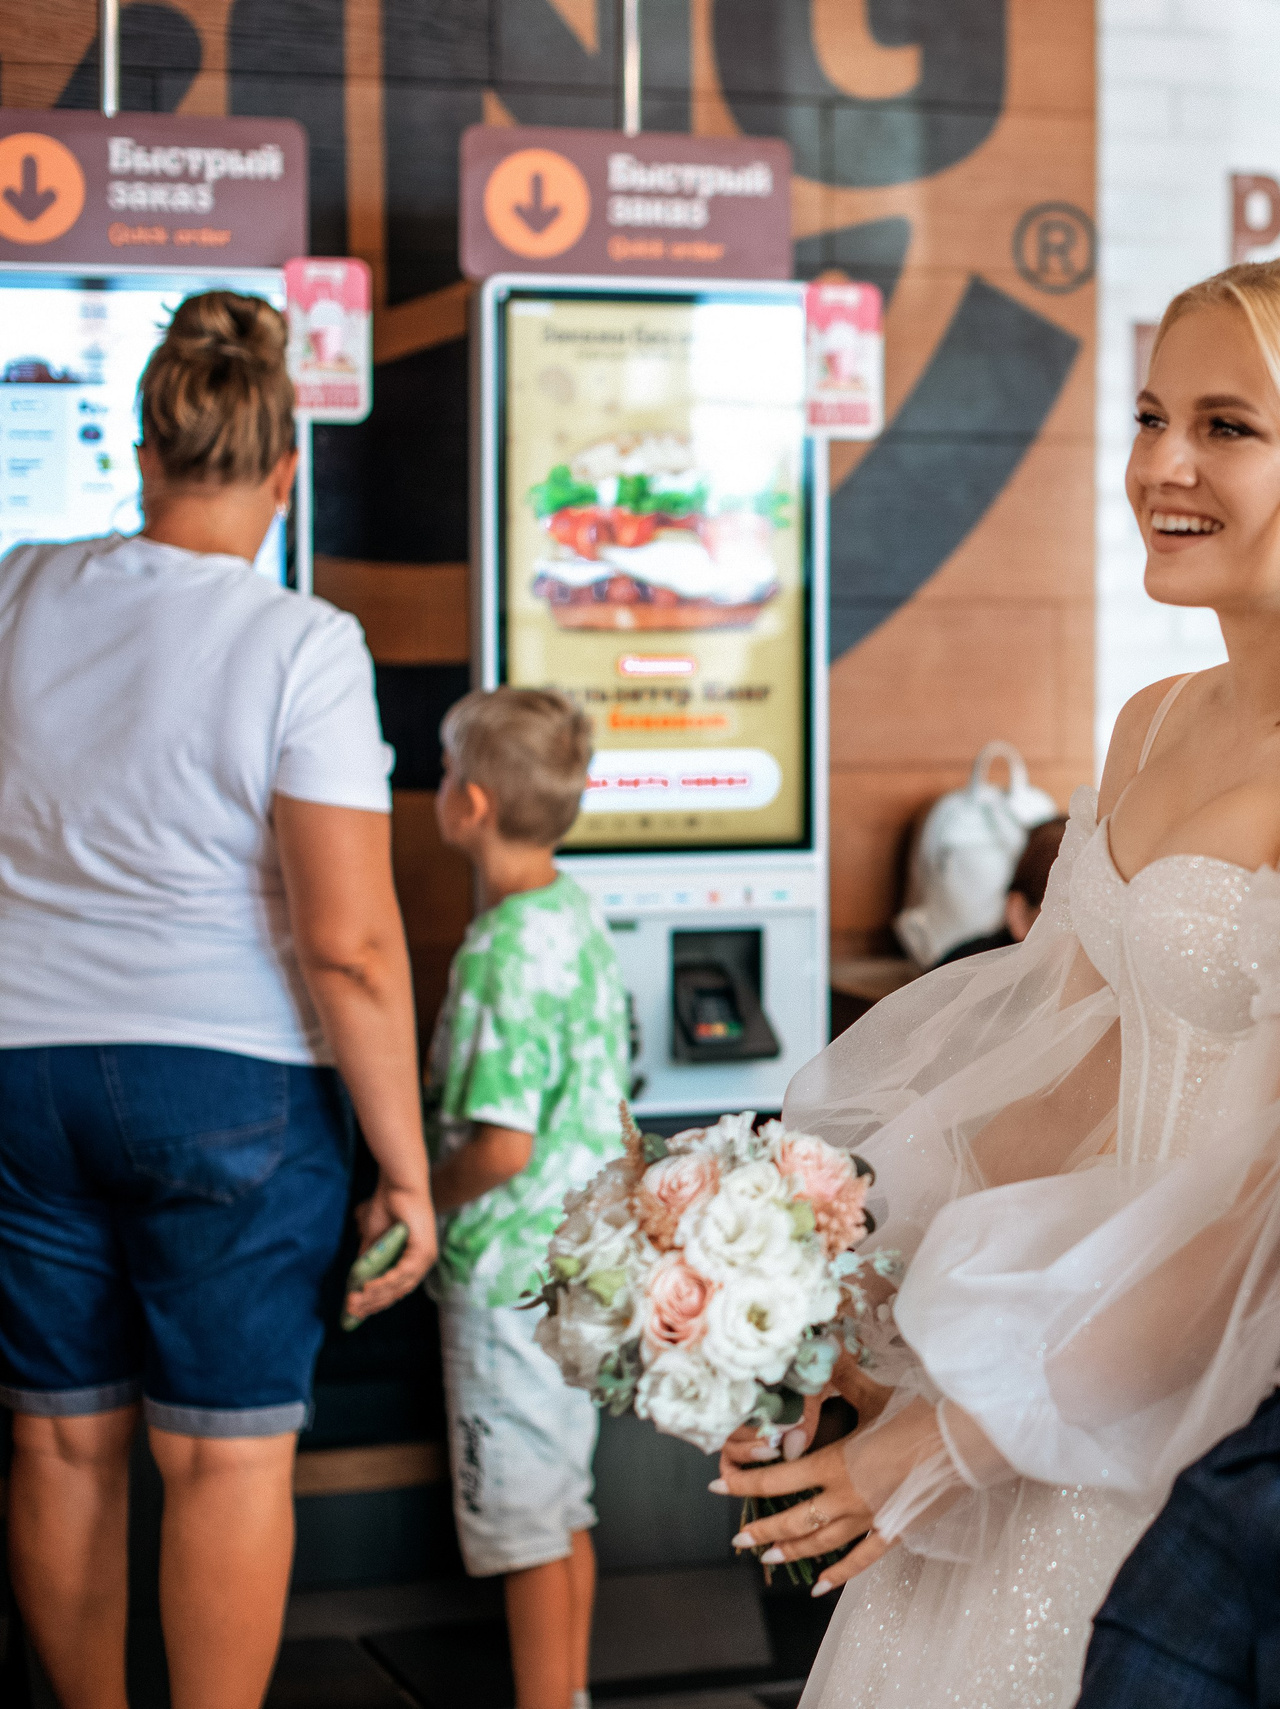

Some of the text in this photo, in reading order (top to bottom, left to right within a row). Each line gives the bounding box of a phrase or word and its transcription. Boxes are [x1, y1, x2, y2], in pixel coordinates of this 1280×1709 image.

[108, 136, 284, 182] Быстрый
[608, 152, 773, 198] Быстрый
[107, 180, 214, 214] заказ
[607, 194, 709, 230] заказ
[107, 221, 232, 247] Quick order
[607, 235, 725, 262] Quick order
